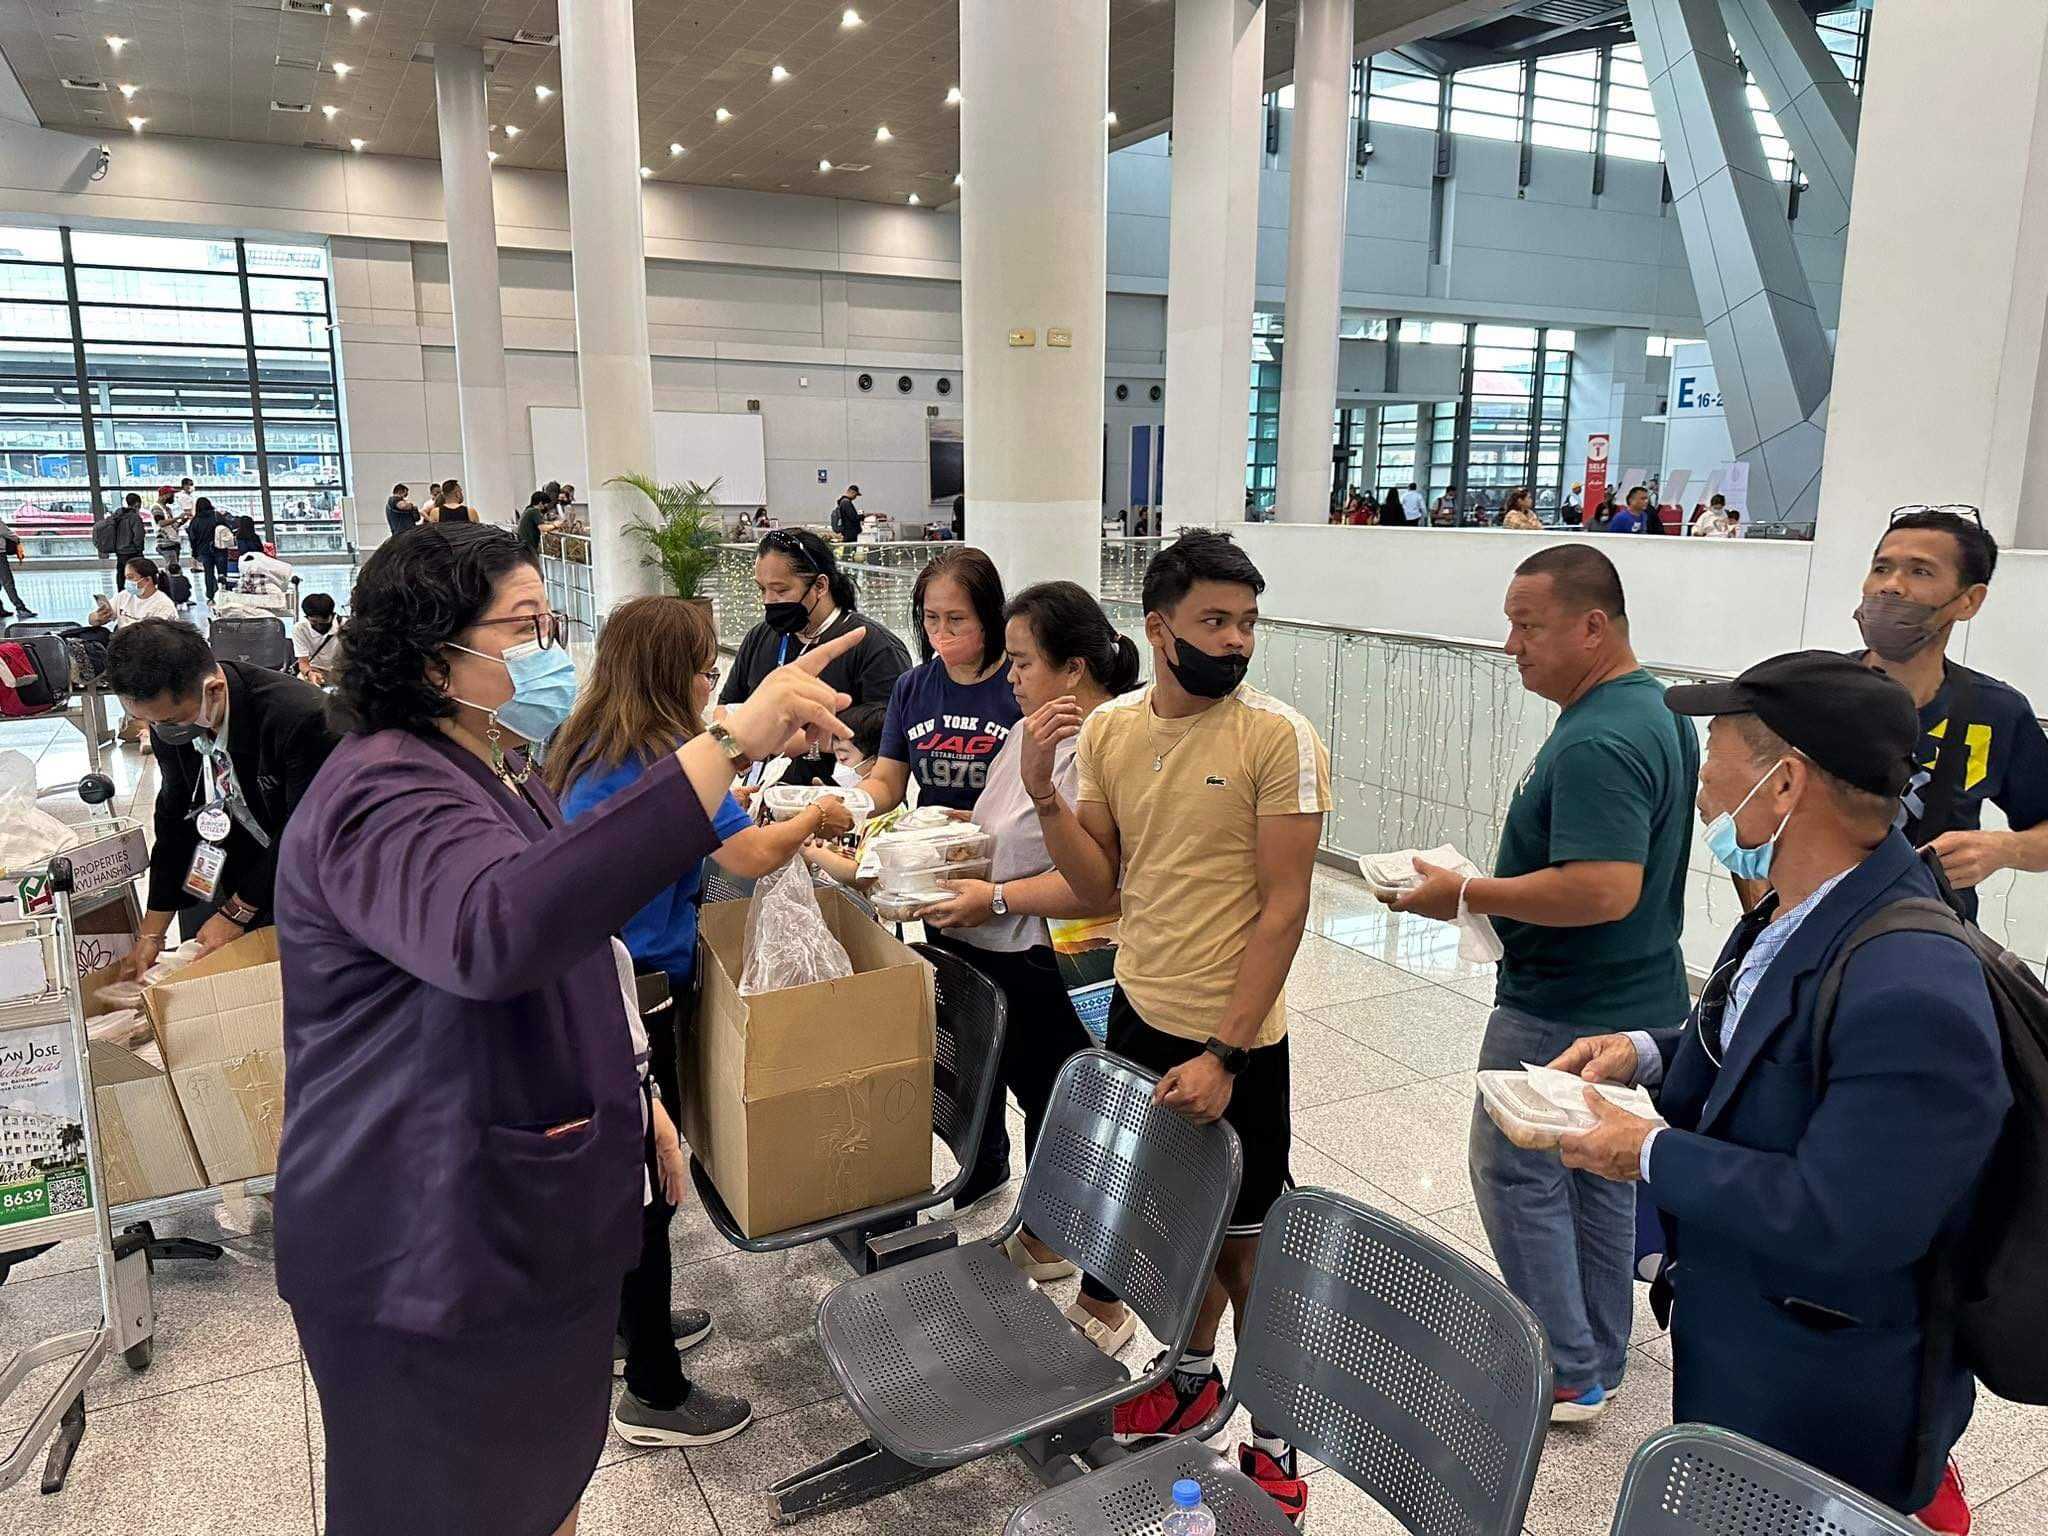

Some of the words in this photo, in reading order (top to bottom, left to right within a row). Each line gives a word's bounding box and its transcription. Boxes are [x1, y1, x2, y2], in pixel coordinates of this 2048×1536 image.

[1678, 377, 1696, 408] E
[1696, 392, 1724, 408] 16-2
[1595, 447, 1601, 457] 1
[907, 718, 936, 742] NEW
[943, 714, 980, 731] YORK
[983, 721, 1010, 740] CIT
[916, 733, 997, 754] JAG
[930, 751, 976, 761] ESTABLISHED
[918, 757, 988, 788] 1976
[73, 849, 129, 879] PROPERTIES
[93, 863, 132, 886] HANSHIN
[25, 1042, 60, 1065] JOSE
[3, 1188, 44, 1208] 8639
